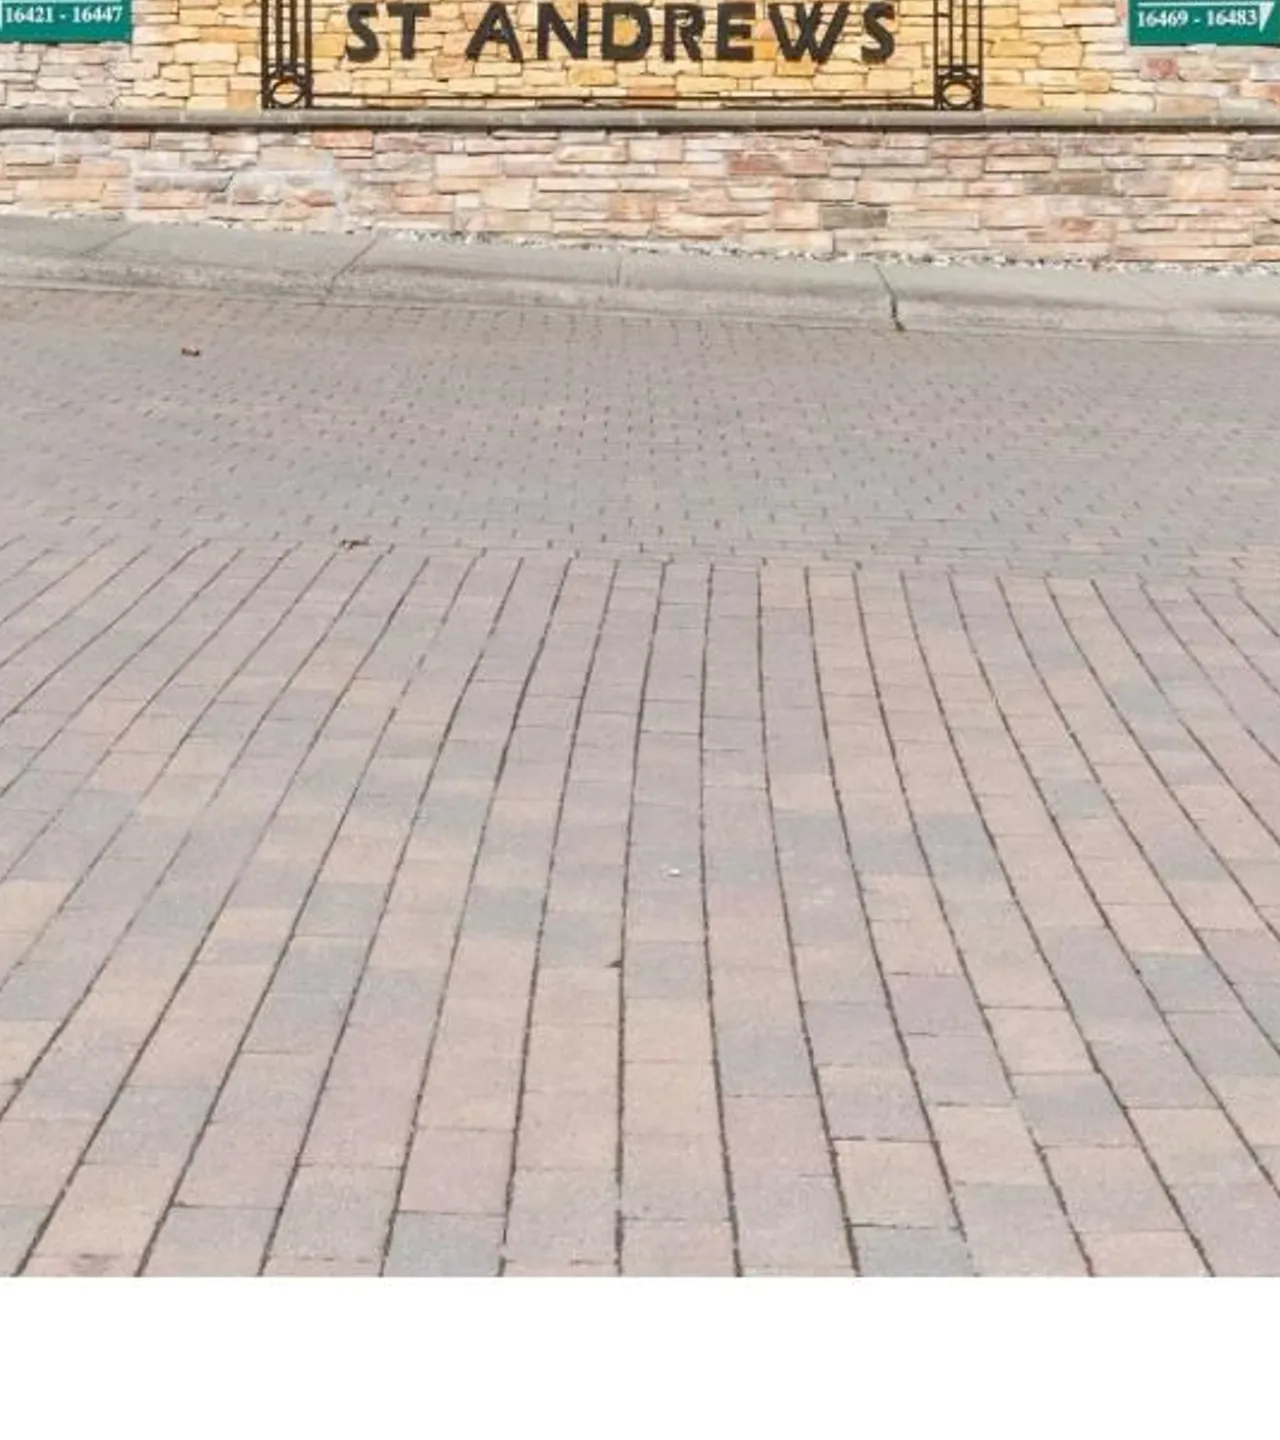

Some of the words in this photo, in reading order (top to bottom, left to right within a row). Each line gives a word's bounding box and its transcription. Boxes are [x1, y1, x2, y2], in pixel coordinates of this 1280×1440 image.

[6, 6, 54, 23] 16421
[73, 6, 123, 23] 16447
[1137, 10, 1188, 27] 16469
[1206, 10, 1257, 26] 16483
[345, 2, 432, 60] ST
[464, 1, 897, 61] ANDREWS
